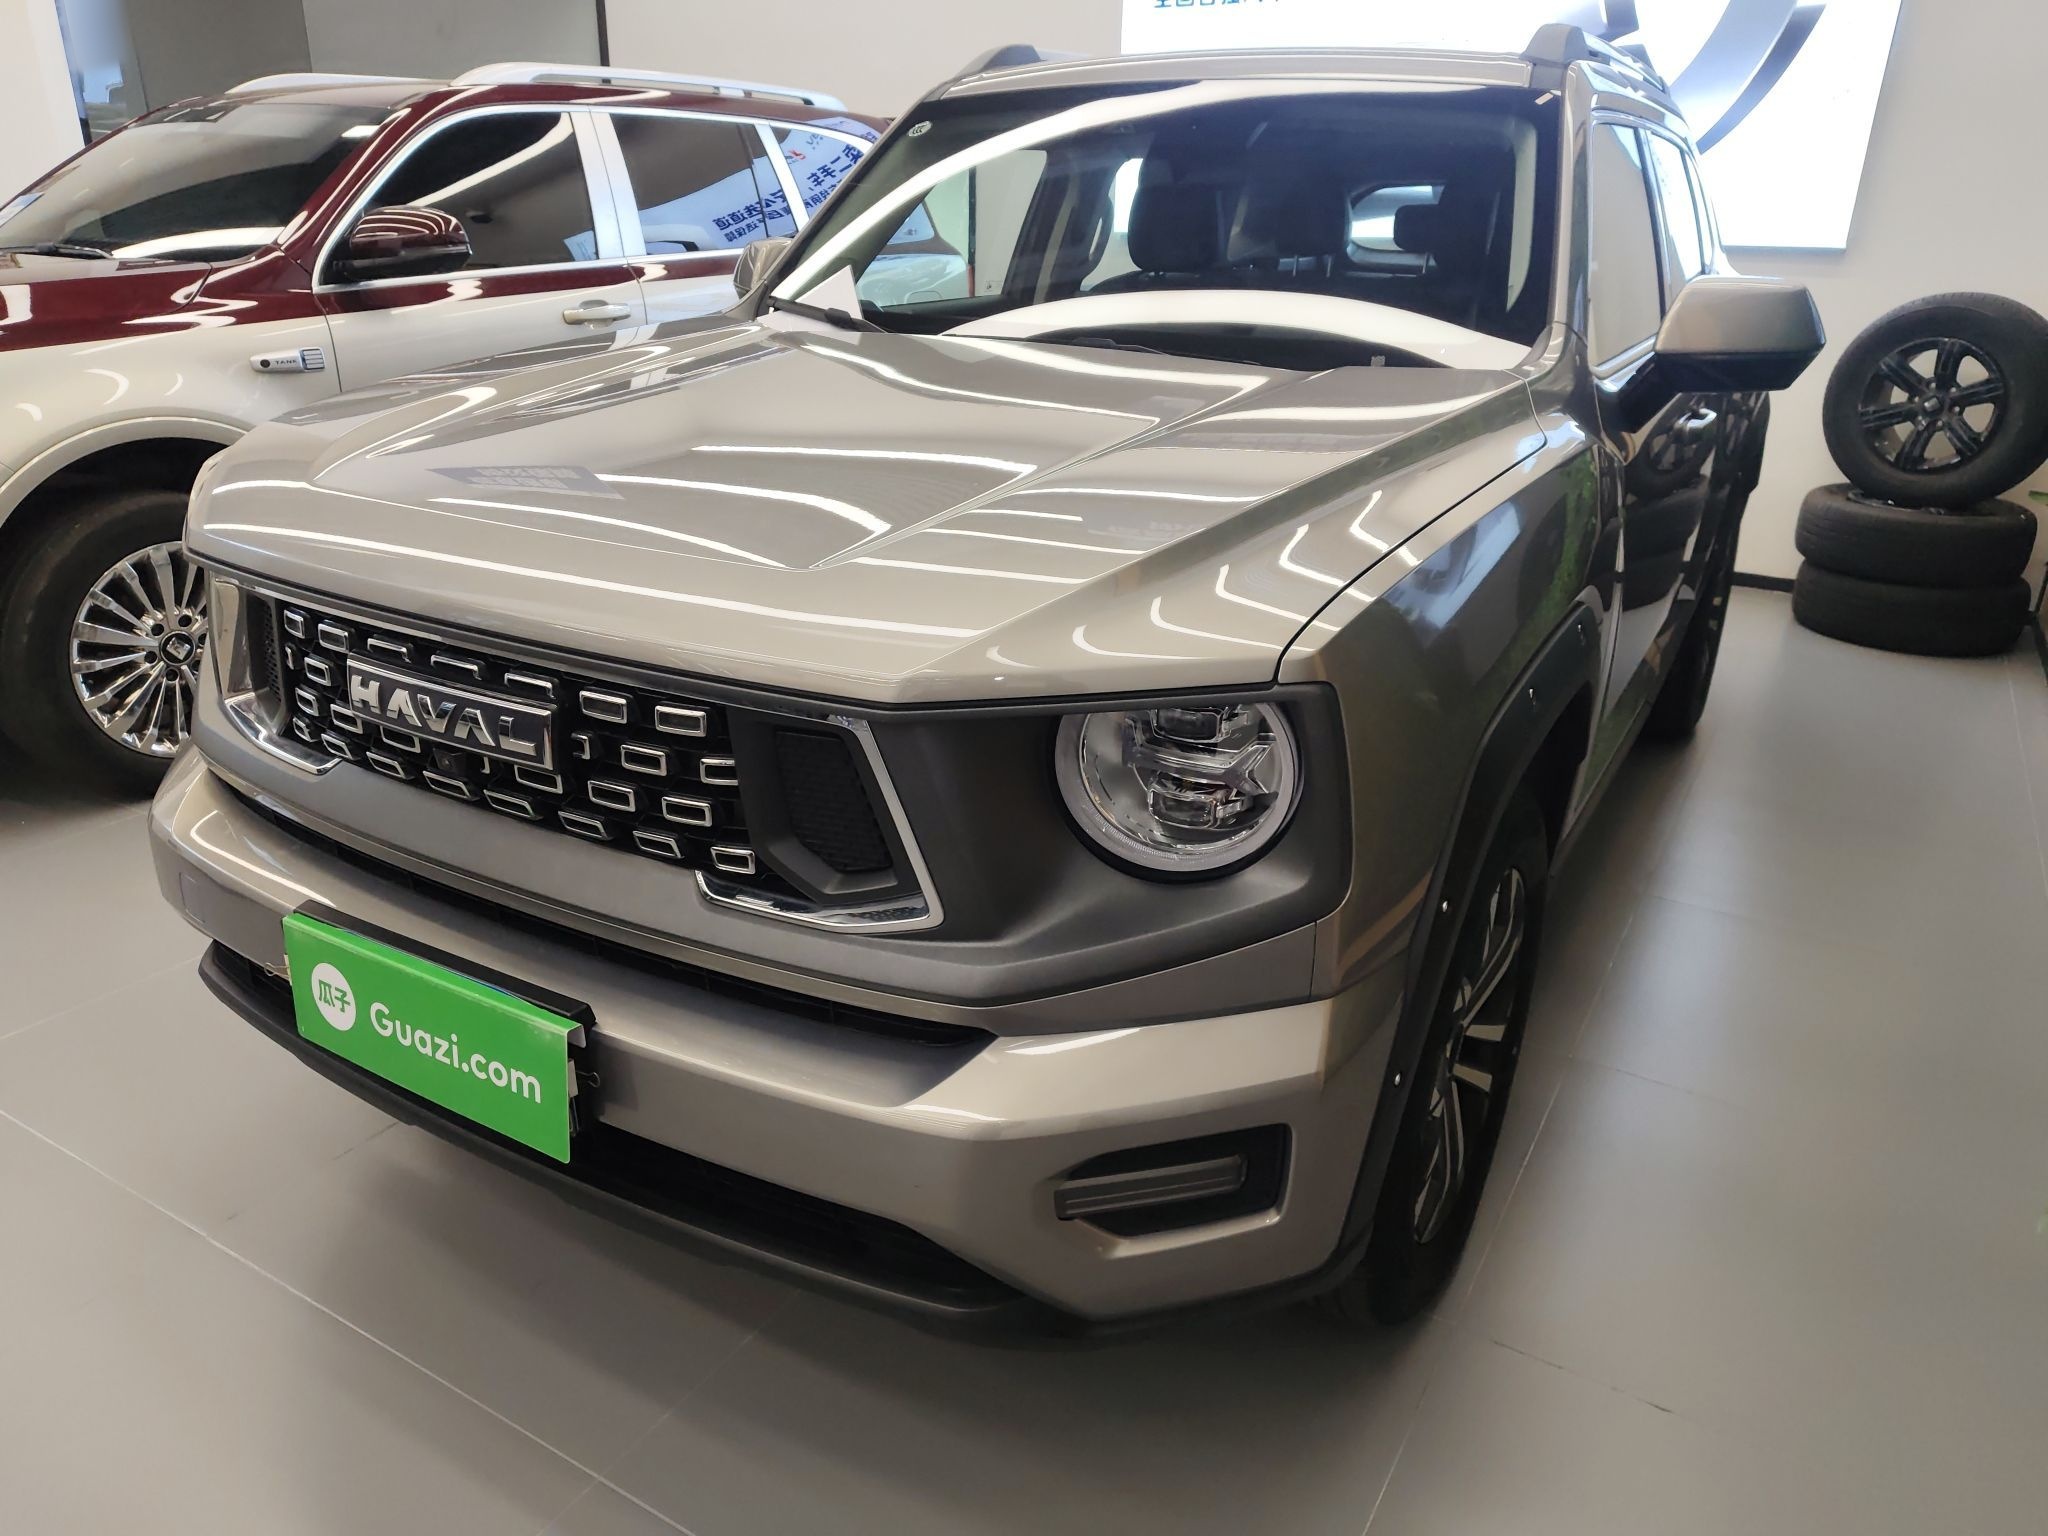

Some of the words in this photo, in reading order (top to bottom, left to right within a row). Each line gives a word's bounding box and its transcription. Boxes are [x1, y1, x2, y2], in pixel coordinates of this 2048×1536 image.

[350, 674, 537, 757] HAVAL
[318, 978, 351, 1013] 瓜子
[369, 1001, 542, 1105] Guazi.com
